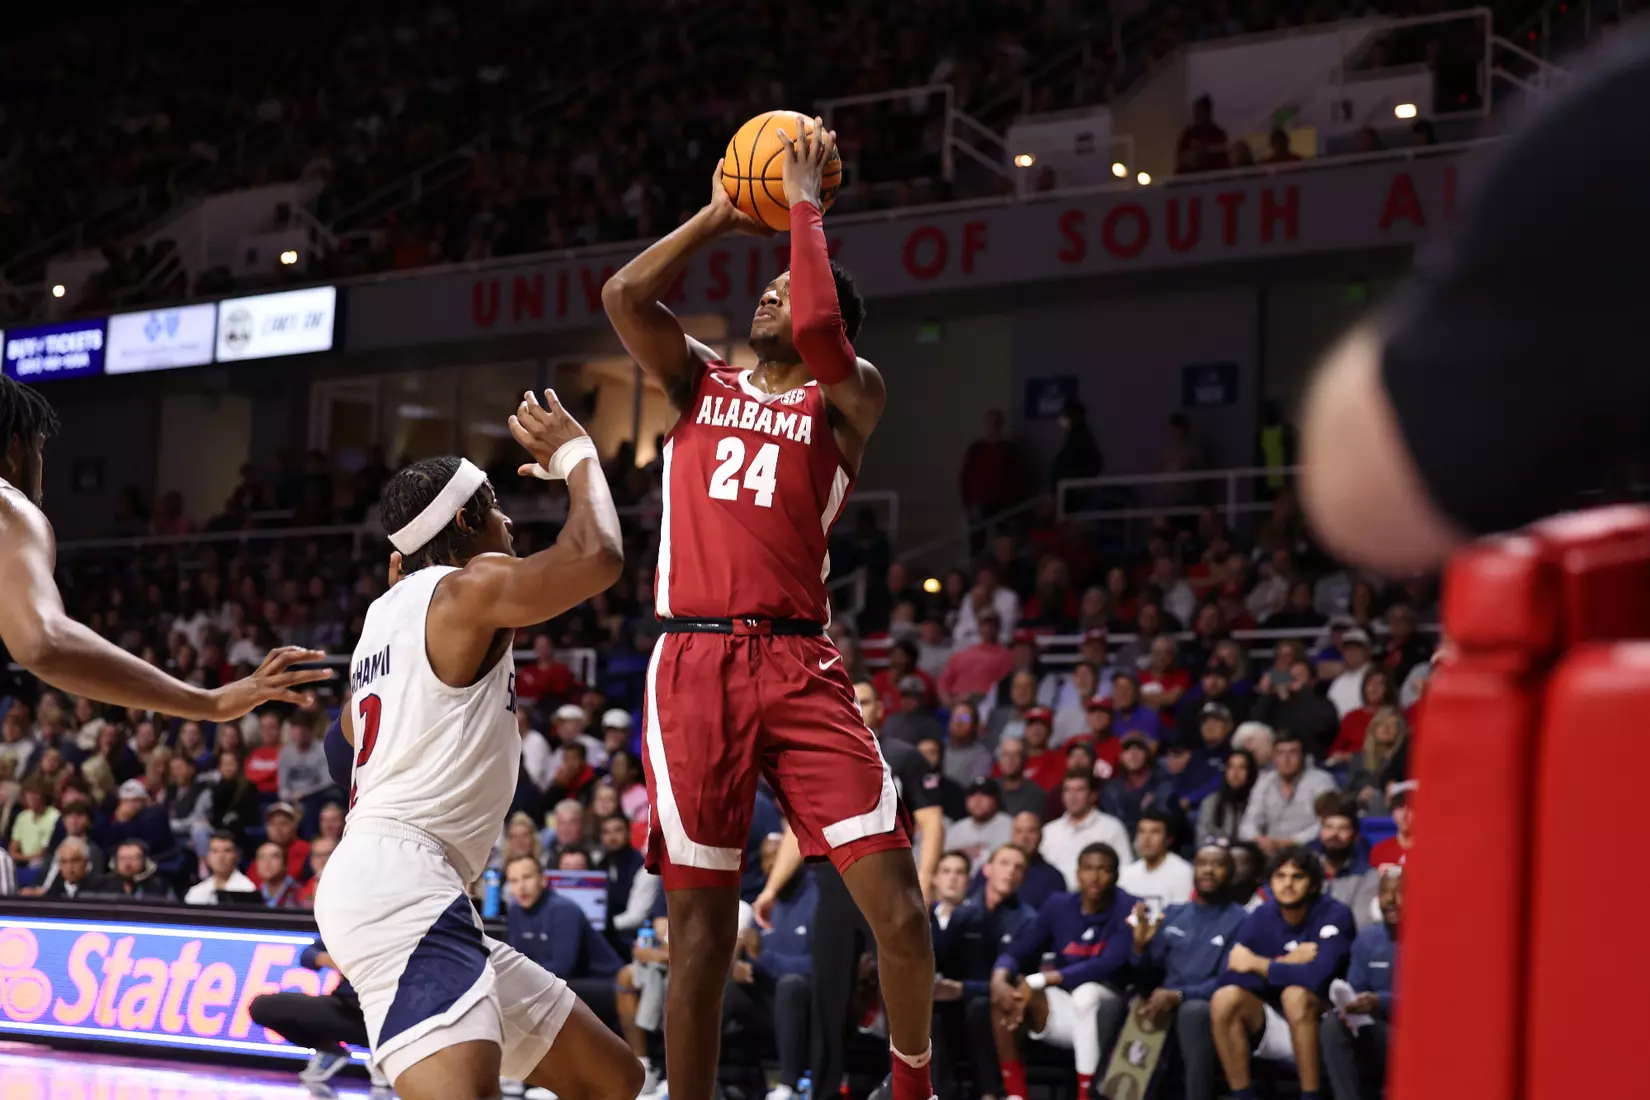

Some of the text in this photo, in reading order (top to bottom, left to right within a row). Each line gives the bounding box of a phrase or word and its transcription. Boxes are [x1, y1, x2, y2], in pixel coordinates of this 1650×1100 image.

[902, 220, 987, 280] OF
[1057, 186, 1299, 265] SOUTH
[695, 395, 813, 446] ALABAMA
[781, 388, 805, 405] SEC
[708, 436, 780, 509] 24
[53, 931, 236, 1038] State
